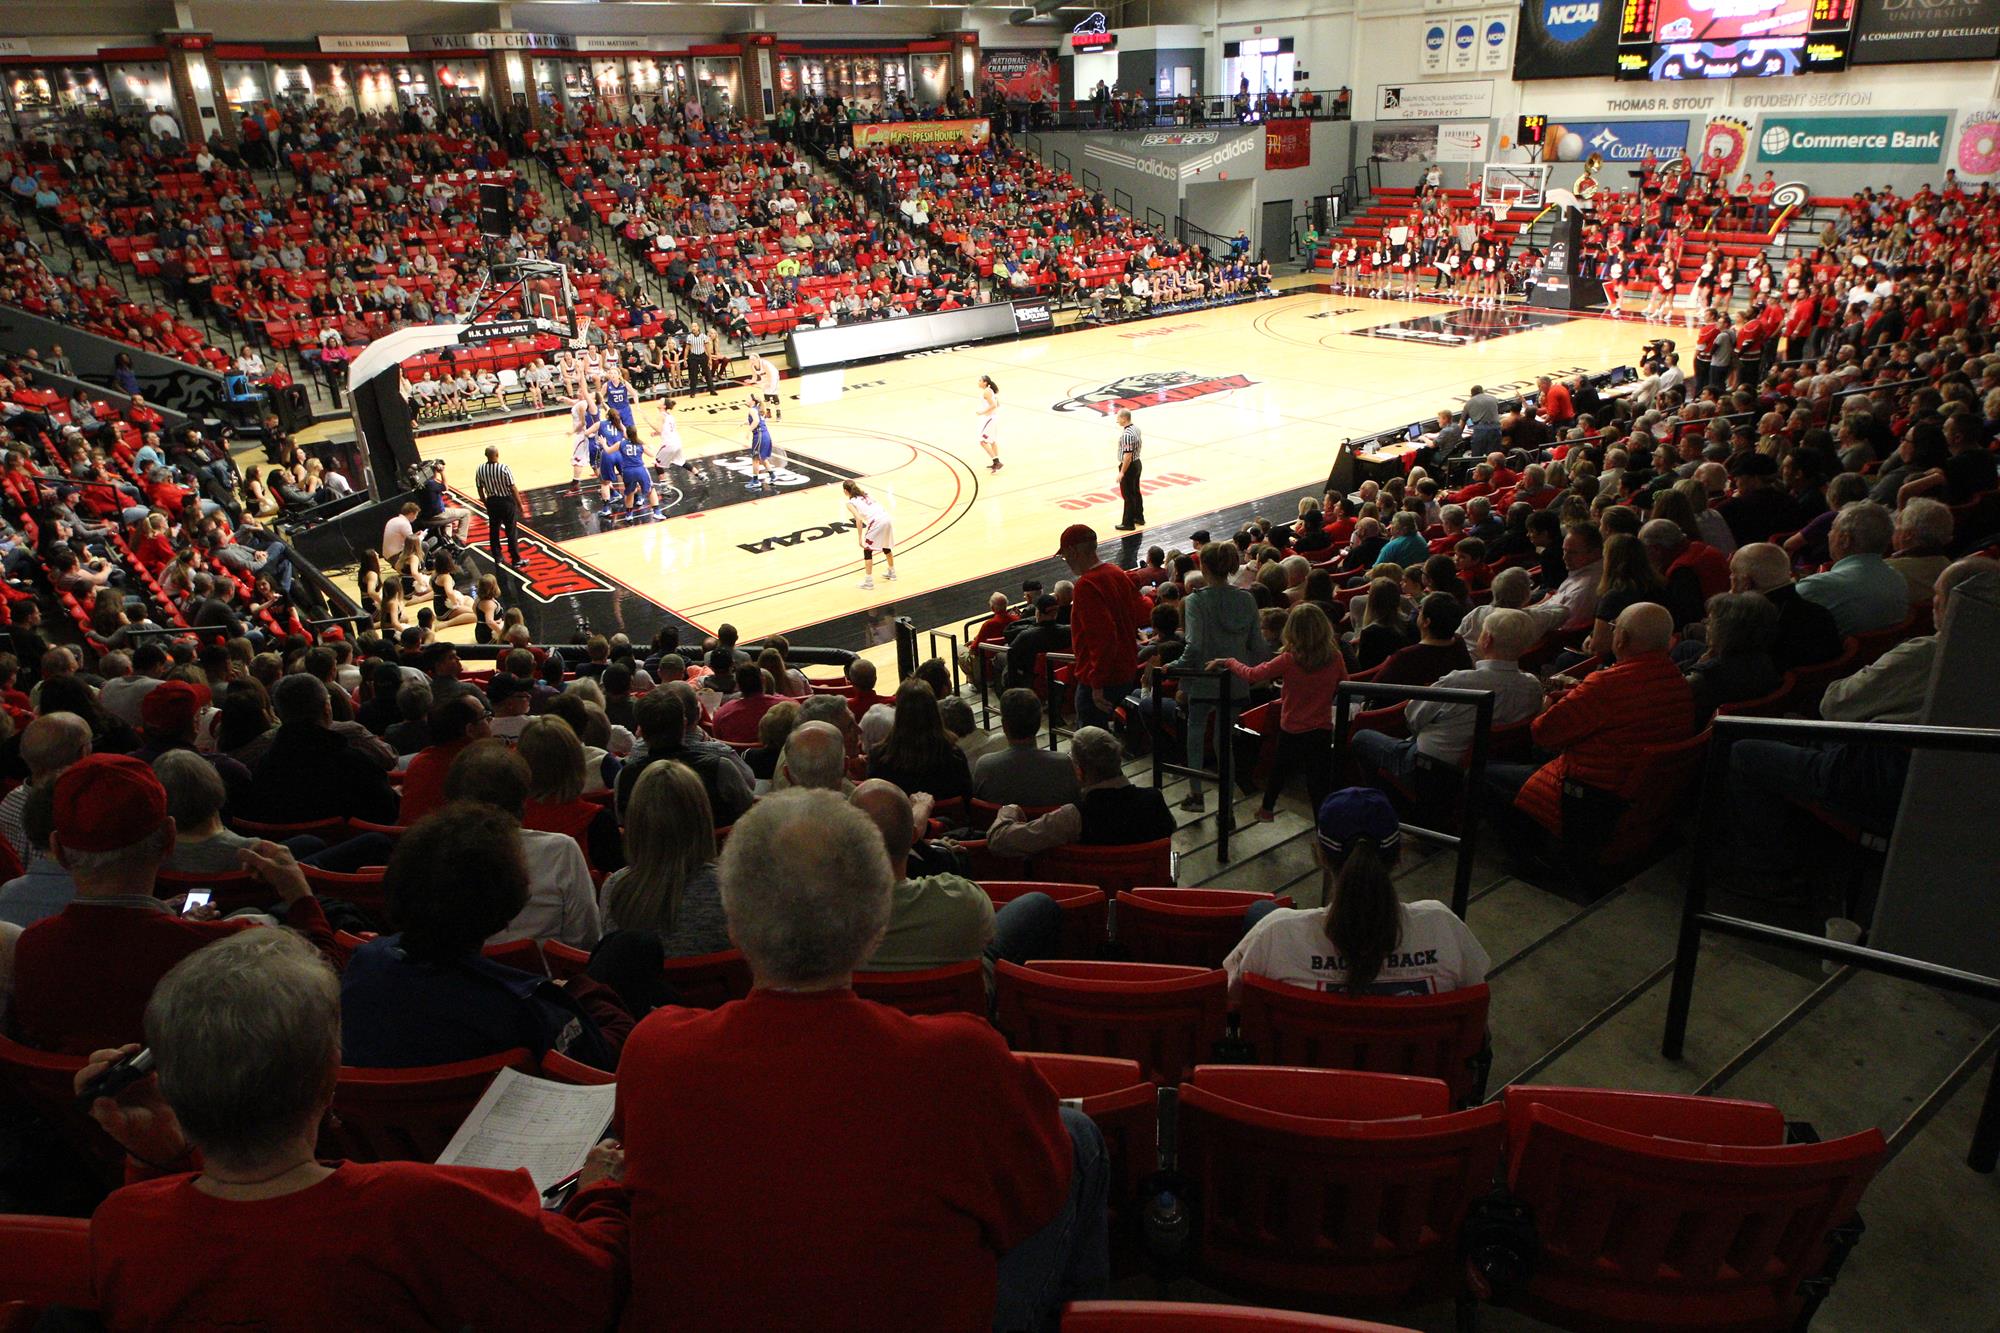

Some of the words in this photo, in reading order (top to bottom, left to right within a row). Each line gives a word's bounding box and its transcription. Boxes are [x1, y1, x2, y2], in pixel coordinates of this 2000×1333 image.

[1547, 3, 1600, 25] NCAA
[1889, 7, 1973, 21] UNIVERSITY
[432, 36, 468, 47] WALL
[478, 35, 496, 46] OF
[505, 35, 570, 47] CHAMPIONS
[1487, 32, 1505, 41] NCAA
[1860, 34, 1867, 42] A
[1868, 31, 1926, 41] COMMUNITY
[1927, 29, 1939, 38] OF
[1942, 26, 2000, 37] EXCELLENCE
[1427, 37, 1444, 46] NCAA
[992, 56, 1025, 64] NATIONAL
[988, 64, 1027, 72] CHAMPIONS
[1607, 99, 1655, 111] THOMAS
[1657, 99, 1669, 110] R.
[1672, 97, 1714, 109] STOUT
[1743, 93, 1805, 107] STUDENT
[1810, 91, 1872, 106] SECTION
[912, 130, 933, 143] FRESH
[1792, 131, 1886, 148] Commerce
[1892, 131, 1940, 148] Bank
[1213, 137, 1255, 165] adidas
[1137, 158, 1177, 181] adidas
[502, 325, 529, 334] SUPPLY
[607, 424, 618, 436] 41
[626, 444, 637, 456] 21
[736, 518, 866, 554] NCAA
[1388, 949, 1438, 968] BACK
